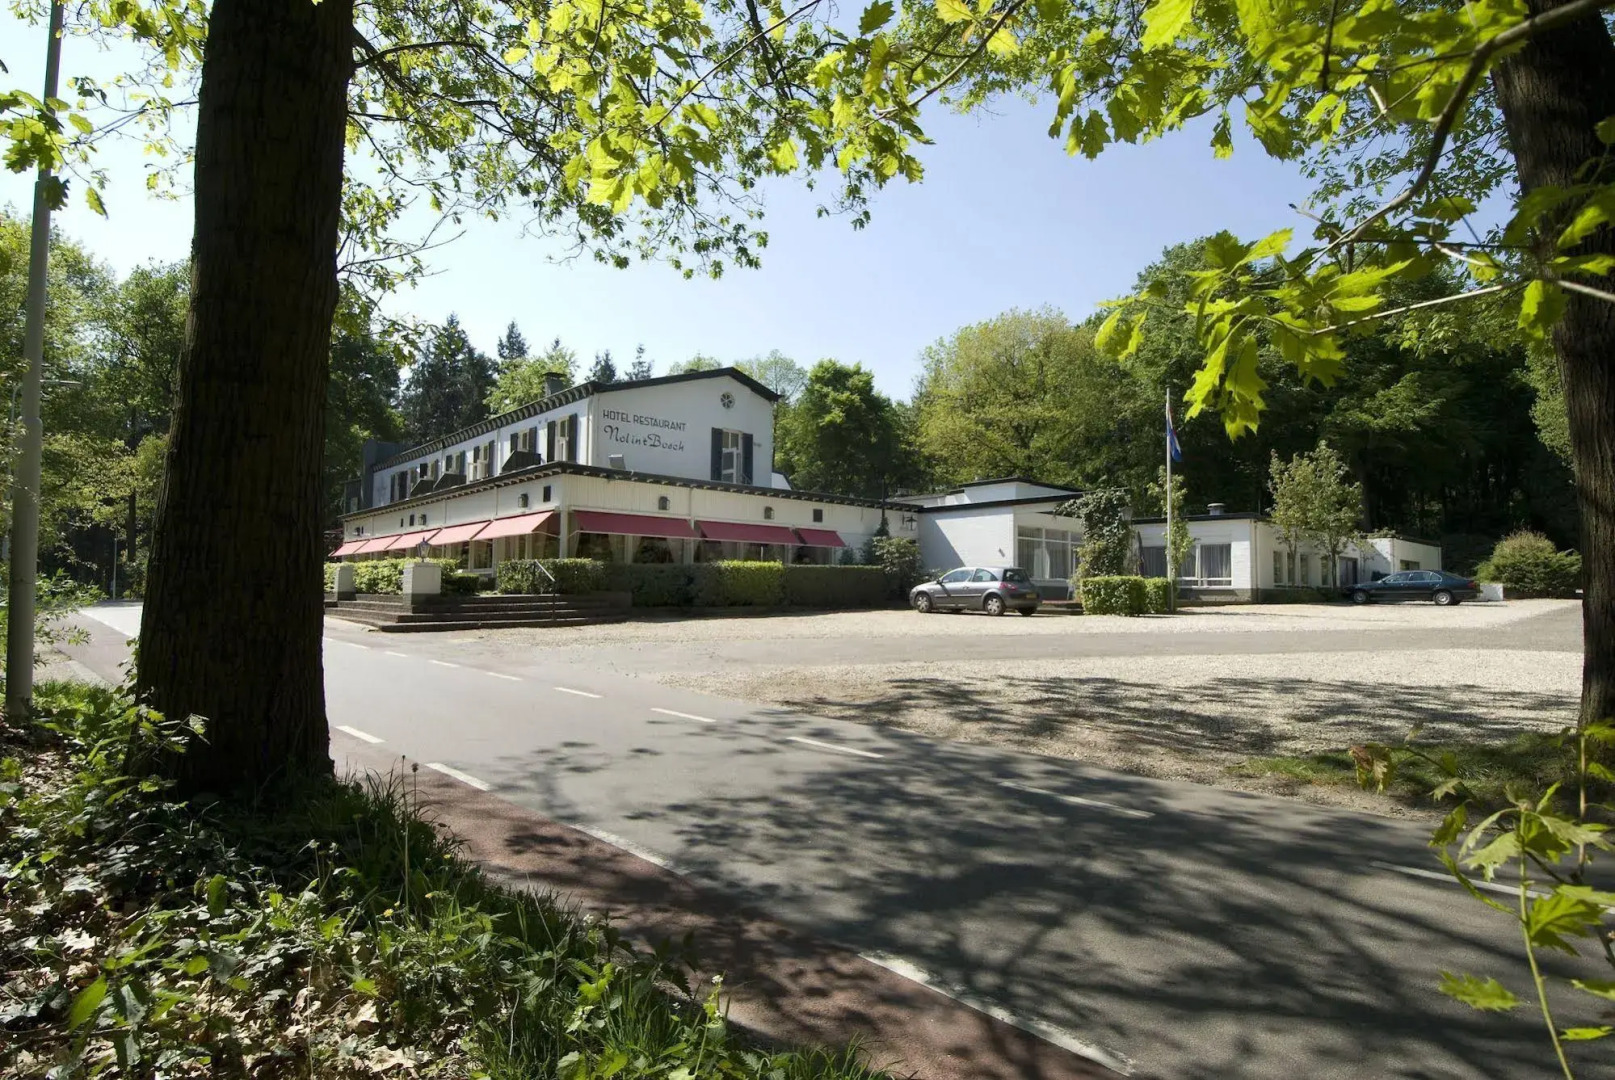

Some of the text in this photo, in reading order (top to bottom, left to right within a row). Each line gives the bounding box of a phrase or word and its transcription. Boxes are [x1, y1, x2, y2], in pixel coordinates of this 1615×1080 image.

[603, 409, 687, 431] HOTEL RESTAURANT
[647, 433, 684, 452] Bosch
